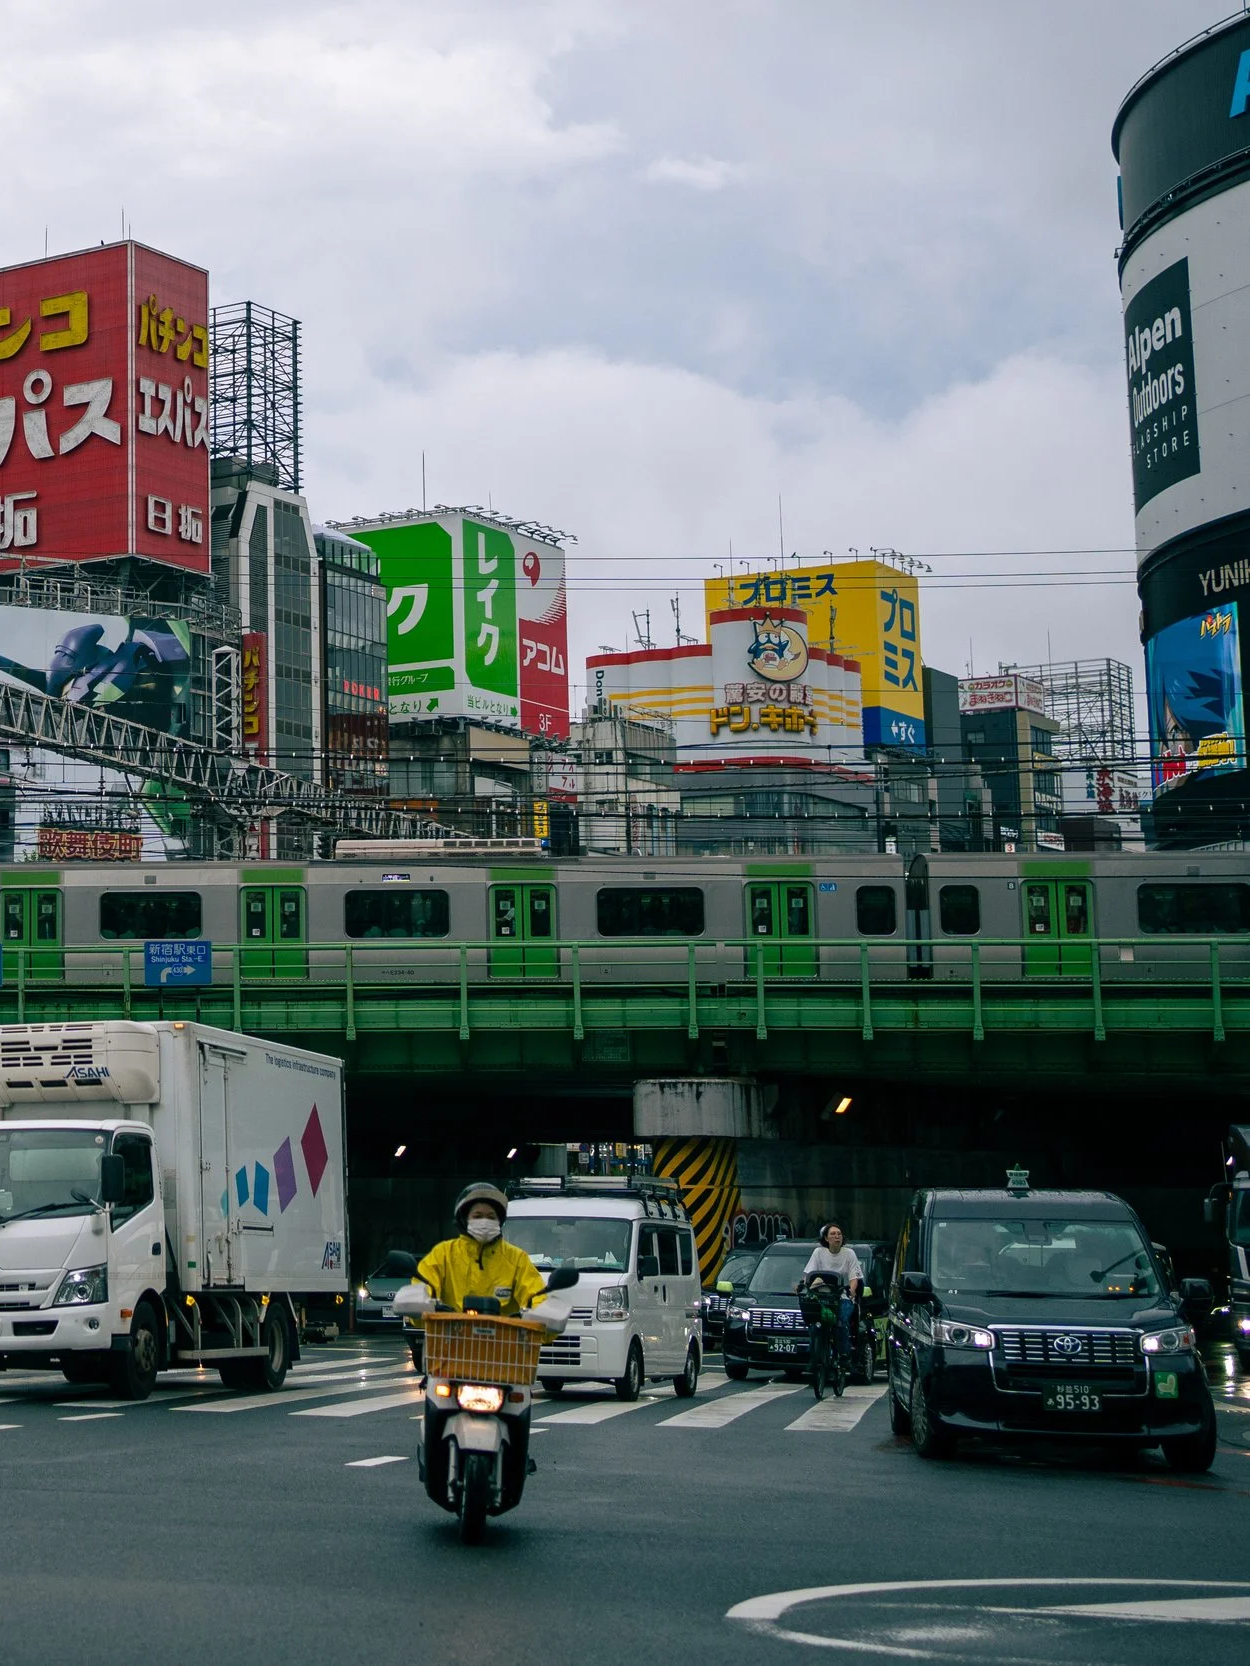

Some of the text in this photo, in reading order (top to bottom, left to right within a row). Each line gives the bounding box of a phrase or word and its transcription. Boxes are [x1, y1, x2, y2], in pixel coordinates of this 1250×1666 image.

[138, 293, 208, 368] パチンコ
[1128, 306, 1183, 380] Alpen
[1132, 363, 1184, 428] Outdoors
[138, 375, 210, 454] エスパス
[1146, 430, 1190, 468] STORE
[147, 494, 203, 544] 日拓
[476, 531, 500, 666] レイク
[740, 573, 838, 605] プロミス
[522, 638, 566, 676] アコム
[343, 680, 379, 702] POKER
[389, 700, 422, 715] となり
[538, 713, 551, 734] 3F
[899, 721, 915, 744] すぐ
[39, 832, 142, 862] 歌舞伎町
[149, 943, 206, 956] 新宿駅東口
[151, 955, 180, 964] Shinjuku
[65, 1065, 110, 1079] ASAHI
[1056, 1394, 1100, 1410] 95-93
